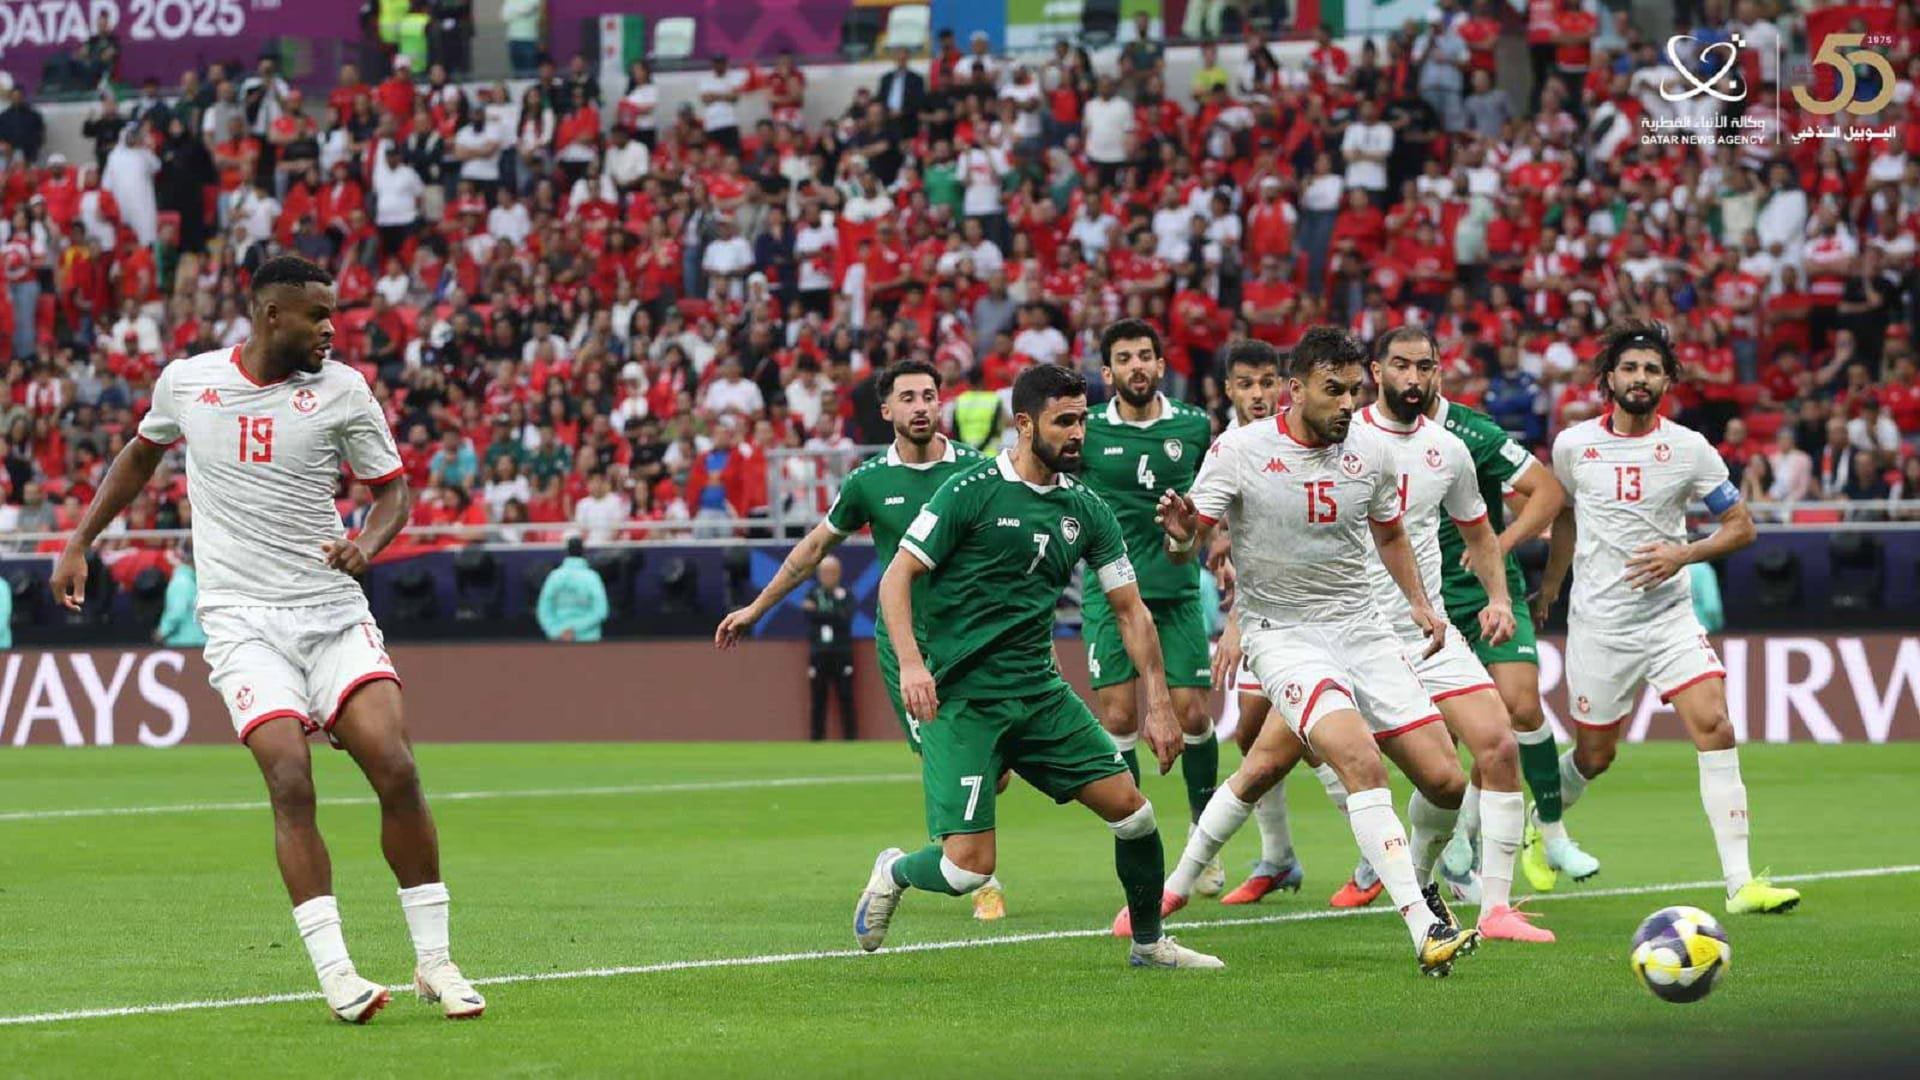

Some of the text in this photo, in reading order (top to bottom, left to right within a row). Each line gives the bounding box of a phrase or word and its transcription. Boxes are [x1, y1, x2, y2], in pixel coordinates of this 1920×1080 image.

[128, 0, 245, 40] 2025
[238, 416, 273, 462] 19
[1137, 455, 1155, 489] 4
[1614, 466, 1641, 501] 13
[1304, 481, 1337, 523] 15
[997, 517, 1020, 528] JAKO
[1027, 533, 1050, 574] 7
[1088, 643, 1100, 678] 4
[0, 650, 190, 748] AYS
[960, 775, 983, 821] 7
